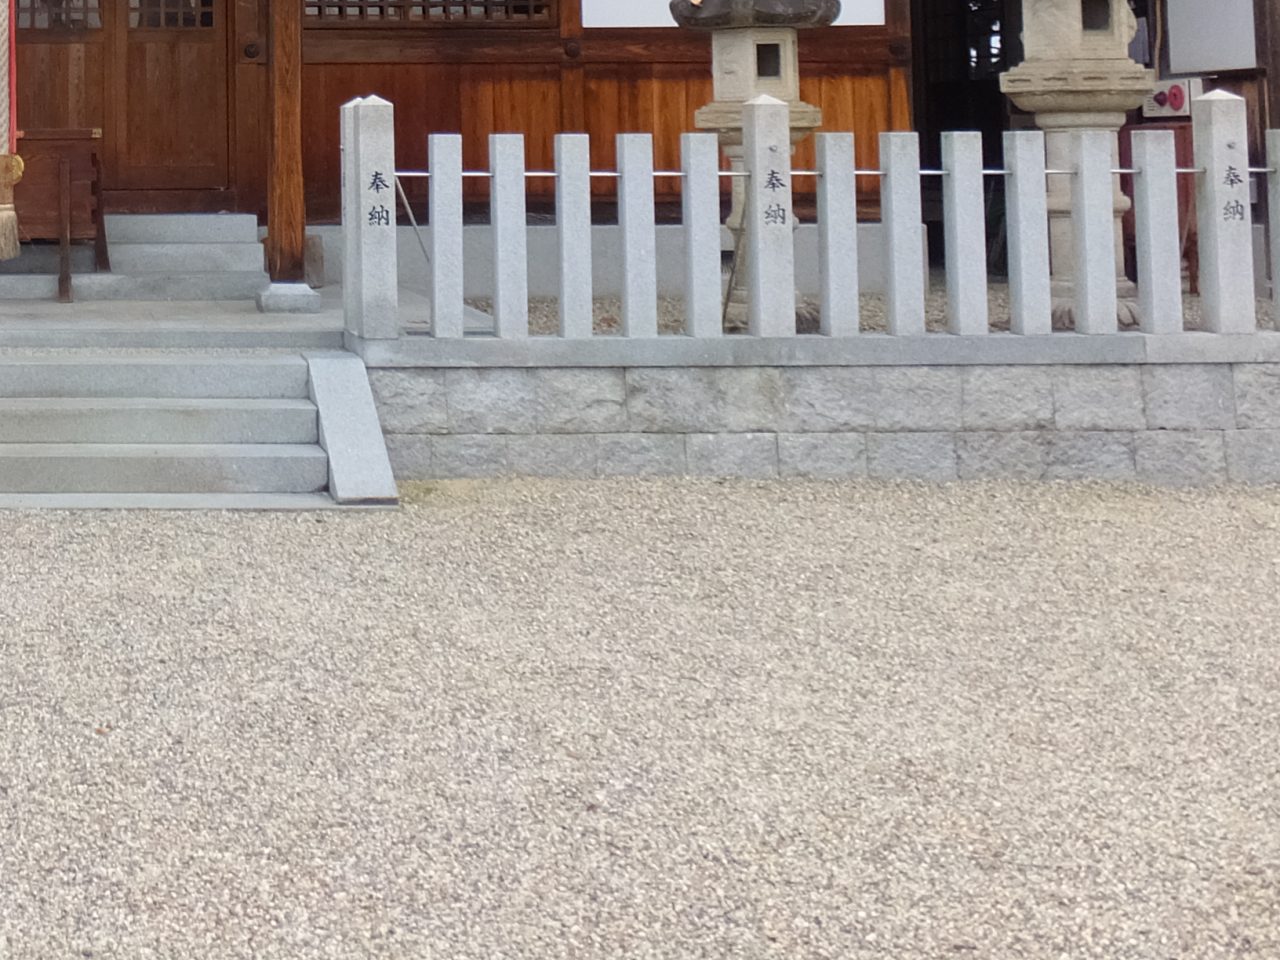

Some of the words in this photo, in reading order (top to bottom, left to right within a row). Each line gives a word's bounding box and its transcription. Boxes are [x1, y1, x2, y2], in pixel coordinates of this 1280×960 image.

[367, 170, 391, 227] 奉納
[763, 168, 787, 226] 奉納
[1222, 165, 1246, 222] 奉納
